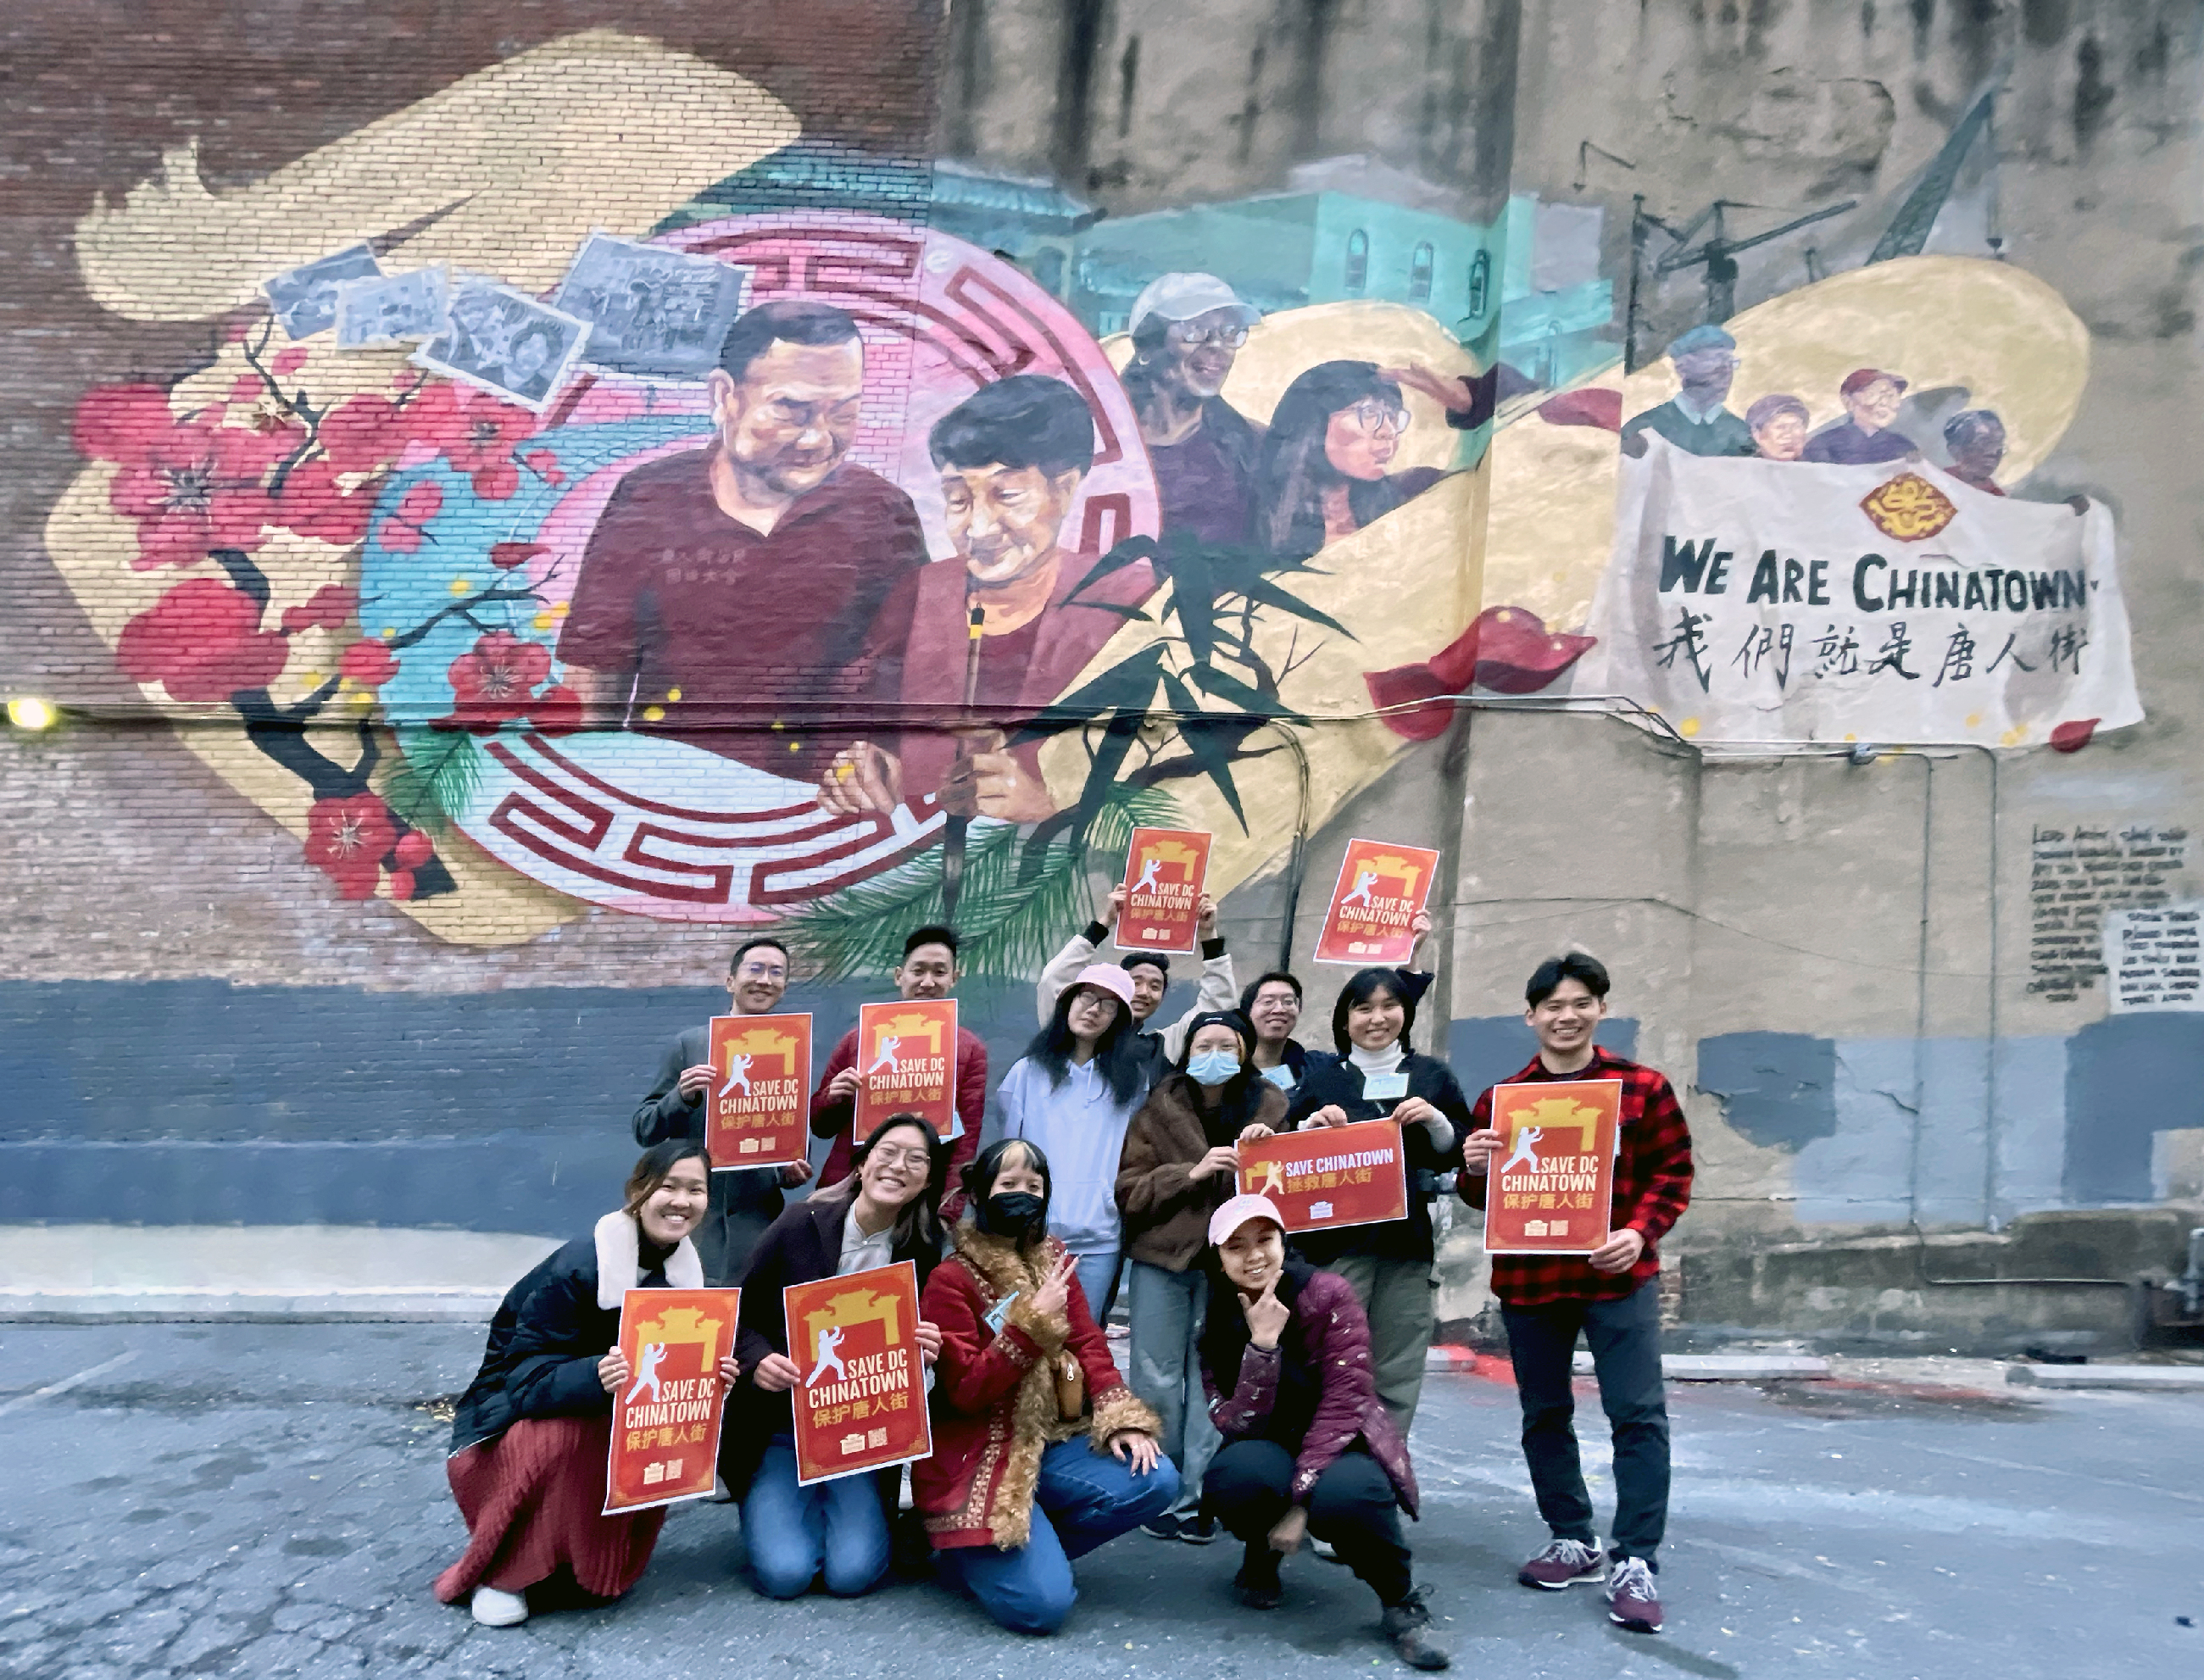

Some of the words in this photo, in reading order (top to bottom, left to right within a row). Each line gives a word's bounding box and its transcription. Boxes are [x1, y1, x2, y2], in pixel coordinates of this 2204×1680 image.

[1659, 535, 1734, 594] WE
[1747, 549, 1830, 605] ARE
[1853, 554, 2086, 612] CHINATOWN
[1653, 605, 2089, 694] 我們就是唐人街
[1158, 882, 1181, 897] SAVE
[1182, 884, 1195, 897] DC
[1131, 894, 1192, 910] CHINATOWN
[1371, 896, 1399, 910] SAVE
[1400, 899, 1414, 913] DC
[1339, 905, 1411, 926] CHINATOWN
[900, 1059, 927, 1073] SAVE
[930, 1057, 945, 1071] DC
[753, 1079, 781, 1097] SAVE
[783, 1078, 799, 1094] DC
[869, 1072, 944, 1090] CHINATOWN
[719, 1095, 798, 1114] CHINATOWN
[1285, 1159, 1314, 1177] SAVE
[1316, 1148, 1394, 1173] CHINATOWN
[1541, 1156, 1575, 1174] SAVE
[1579, 1155, 1599, 1173] DC
[1501, 1174, 1597, 1192] CHINATOWN
[848, 1353, 883, 1379] SAVE
[888, 1348, 908, 1371] DC
[662, 1378, 696, 1403] SAVE
[698, 1377, 716, 1399] DC
[809, 1368, 910, 1409] CHINATOWN
[626, 1399, 711, 1429] CHINATOWN
[812, 1391, 910, 1429] 保护唐人街
